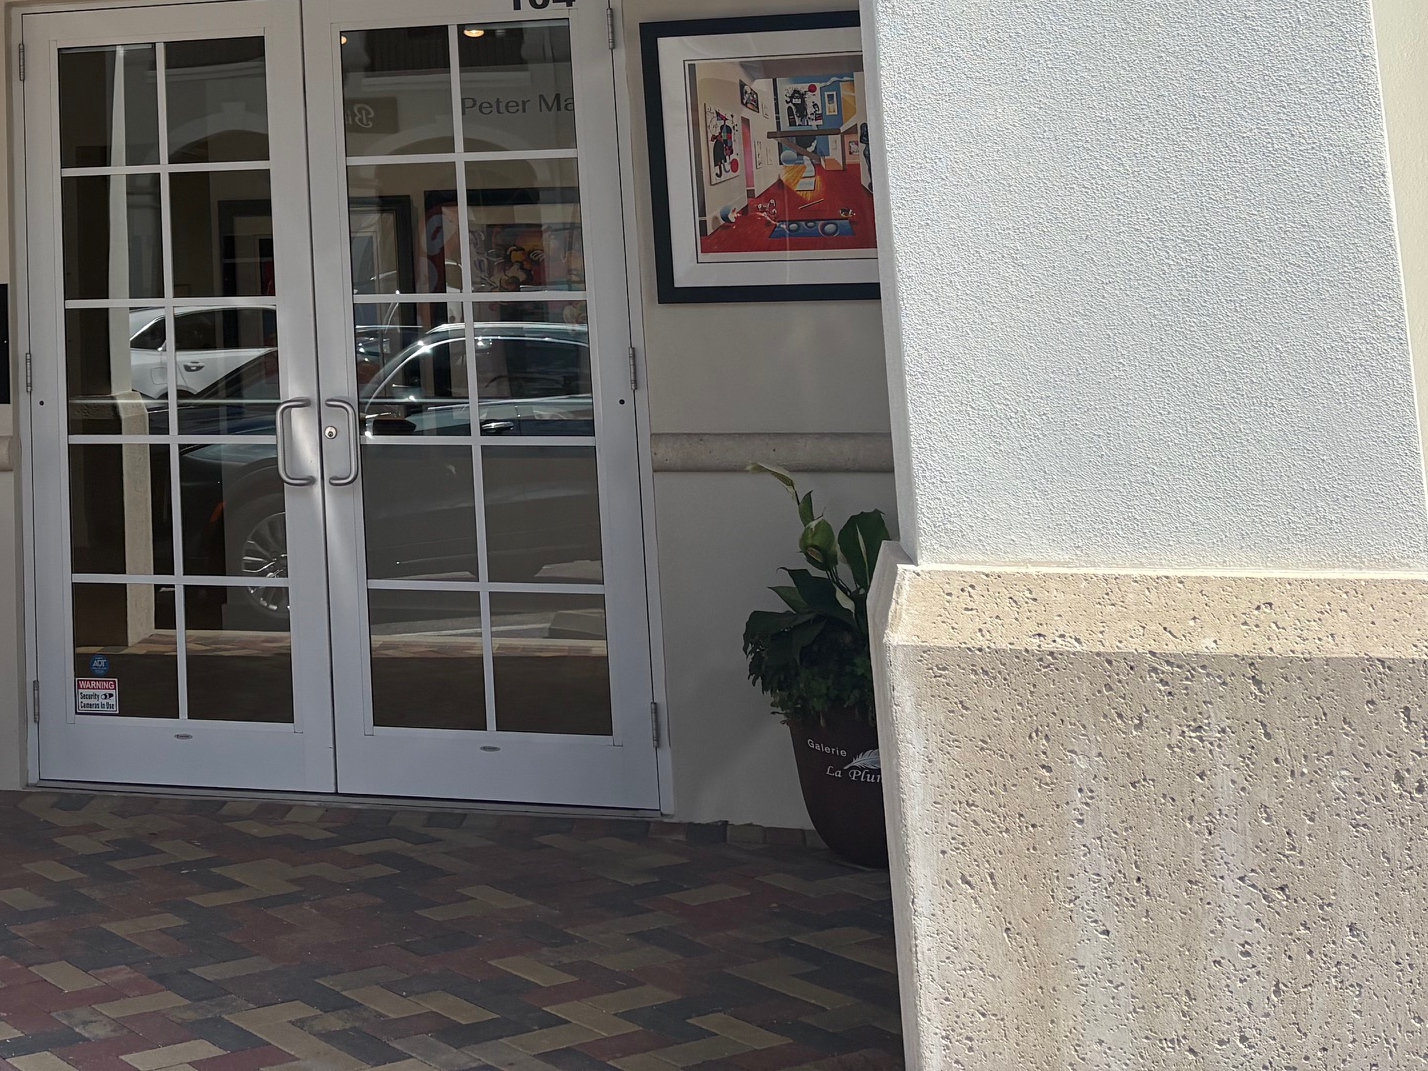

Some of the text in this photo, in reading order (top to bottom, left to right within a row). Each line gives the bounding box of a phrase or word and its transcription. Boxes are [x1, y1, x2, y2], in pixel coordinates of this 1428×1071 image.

[461, 96, 531, 116] Peter
[78, 680, 115, 689] WARNING
[80, 692, 100, 701] Security
[80, 701, 100, 709] Cameras
[807, 738, 847, 757] Galerie
[826, 765, 842, 778] La
